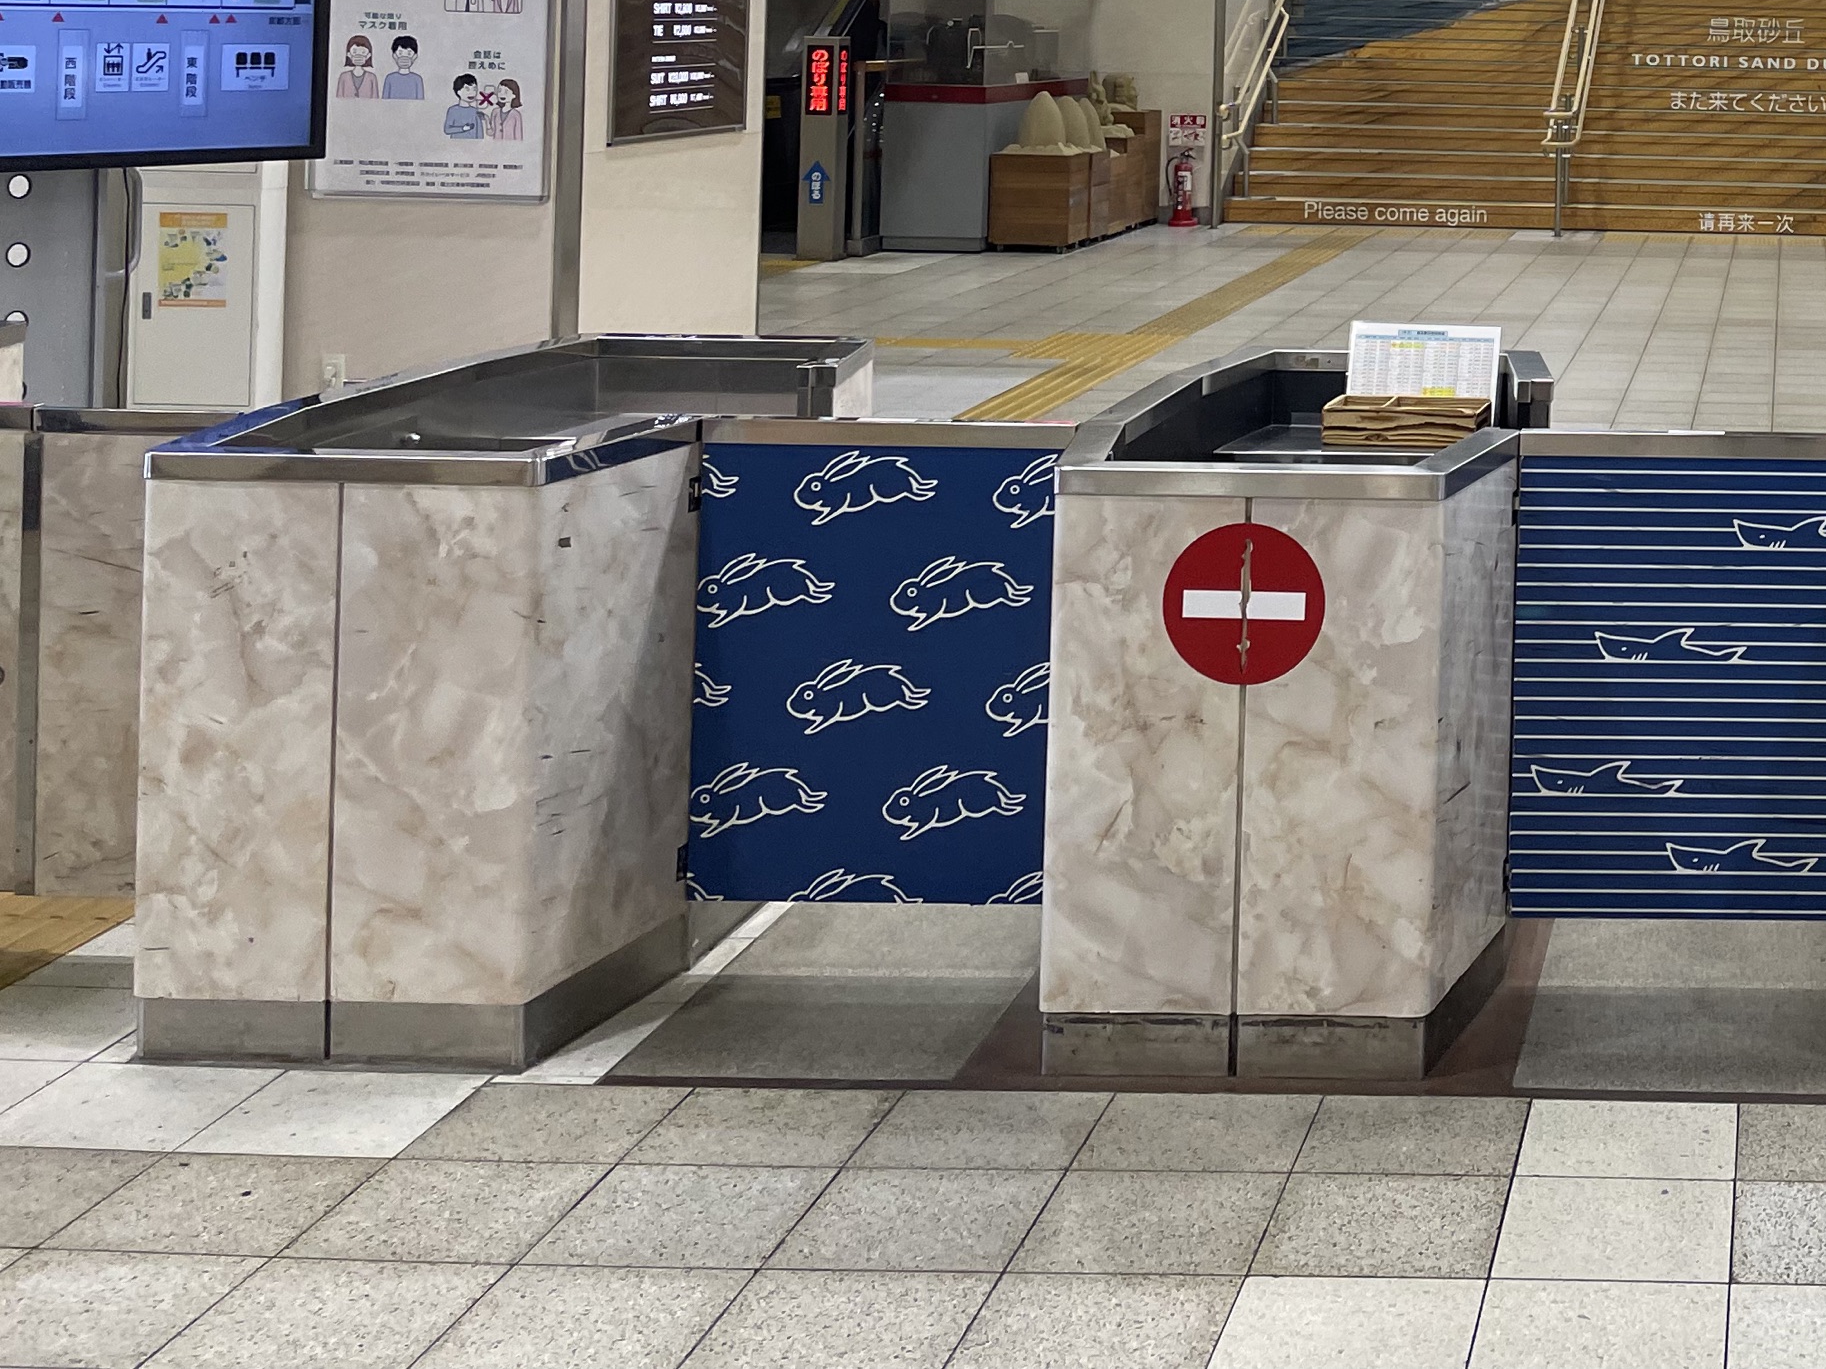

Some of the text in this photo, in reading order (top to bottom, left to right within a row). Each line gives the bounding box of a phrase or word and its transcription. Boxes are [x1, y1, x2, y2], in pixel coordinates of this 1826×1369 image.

[358, 20, 408, 31] マスク着用
[1706, 16, 1806, 44] 鳥取砂丘
[1631, 52, 1729, 68] TOTTORI
[1738, 55, 1797, 70] SAND
[808, 48, 830, 112] のぼり専用
[1303, 200, 1489, 225] Please come again
[1697, 211, 1796, 234] 请再来一次
